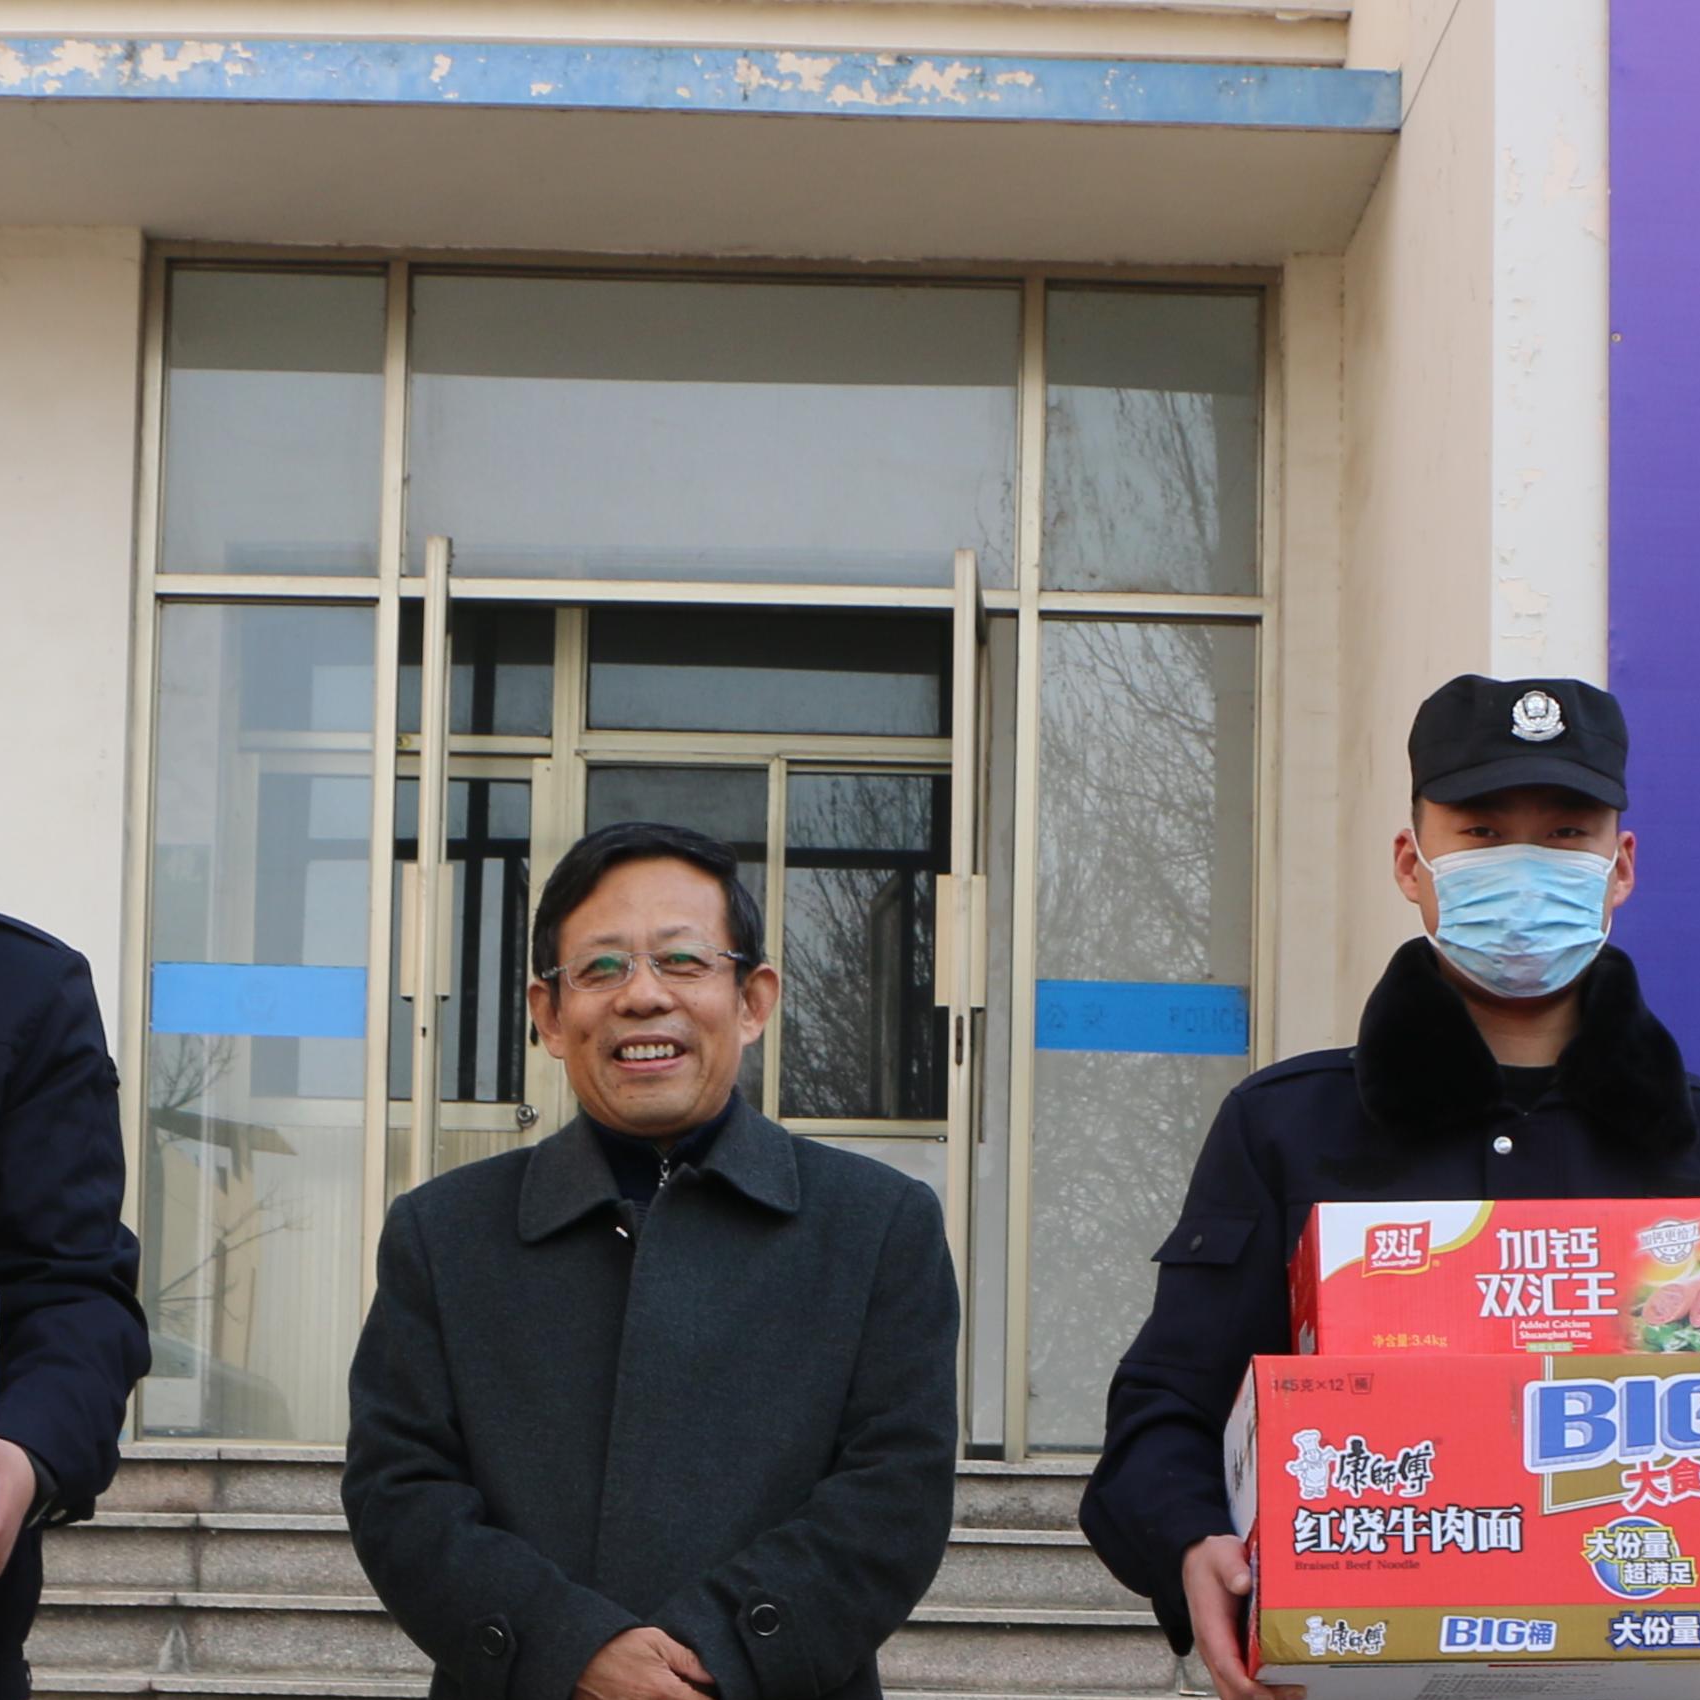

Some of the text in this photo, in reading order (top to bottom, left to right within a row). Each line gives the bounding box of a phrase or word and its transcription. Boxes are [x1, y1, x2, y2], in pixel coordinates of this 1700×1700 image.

[1169, 1006, 1245, 1034] POLICE
[1371, 1227, 1423, 1260] 双汇
[1496, 1226, 1598, 1271] 加钙
[1474, 1272, 1618, 1317] 双汇王
[1519, 1320, 1591, 1330] Added Calcium
[1292, 1504, 1523, 1553] 红烧牛肉面
[1586, 1529, 1671, 1560] 大份量
[1295, 1559, 1420, 1571] Braised Beef Noodle
[1623, 1561, 1693, 1586] 超满足
[1612, 1614, 1700, 1645] 大份量
